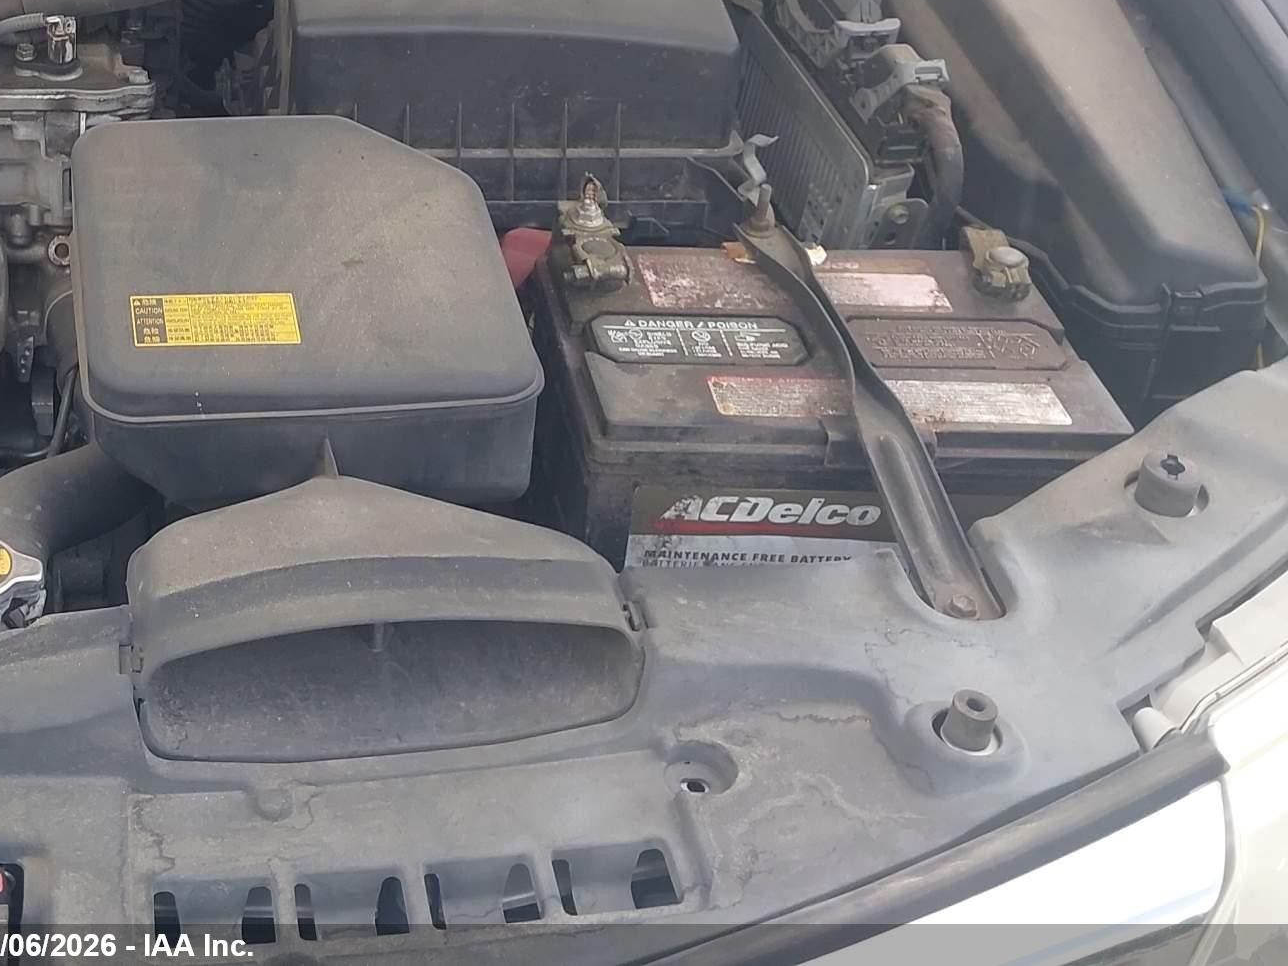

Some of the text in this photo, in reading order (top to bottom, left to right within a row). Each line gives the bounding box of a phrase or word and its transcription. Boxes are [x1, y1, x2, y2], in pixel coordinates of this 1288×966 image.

[134, 306, 163, 315] CAUTION
[637, 319, 694, 329] DANGER
[707, 320, 759, 330] POISON
[660, 494, 882, 526] ACDelco
[643, 549, 747, 563] MAINTENANCE
[752, 552, 786, 563] FREE
